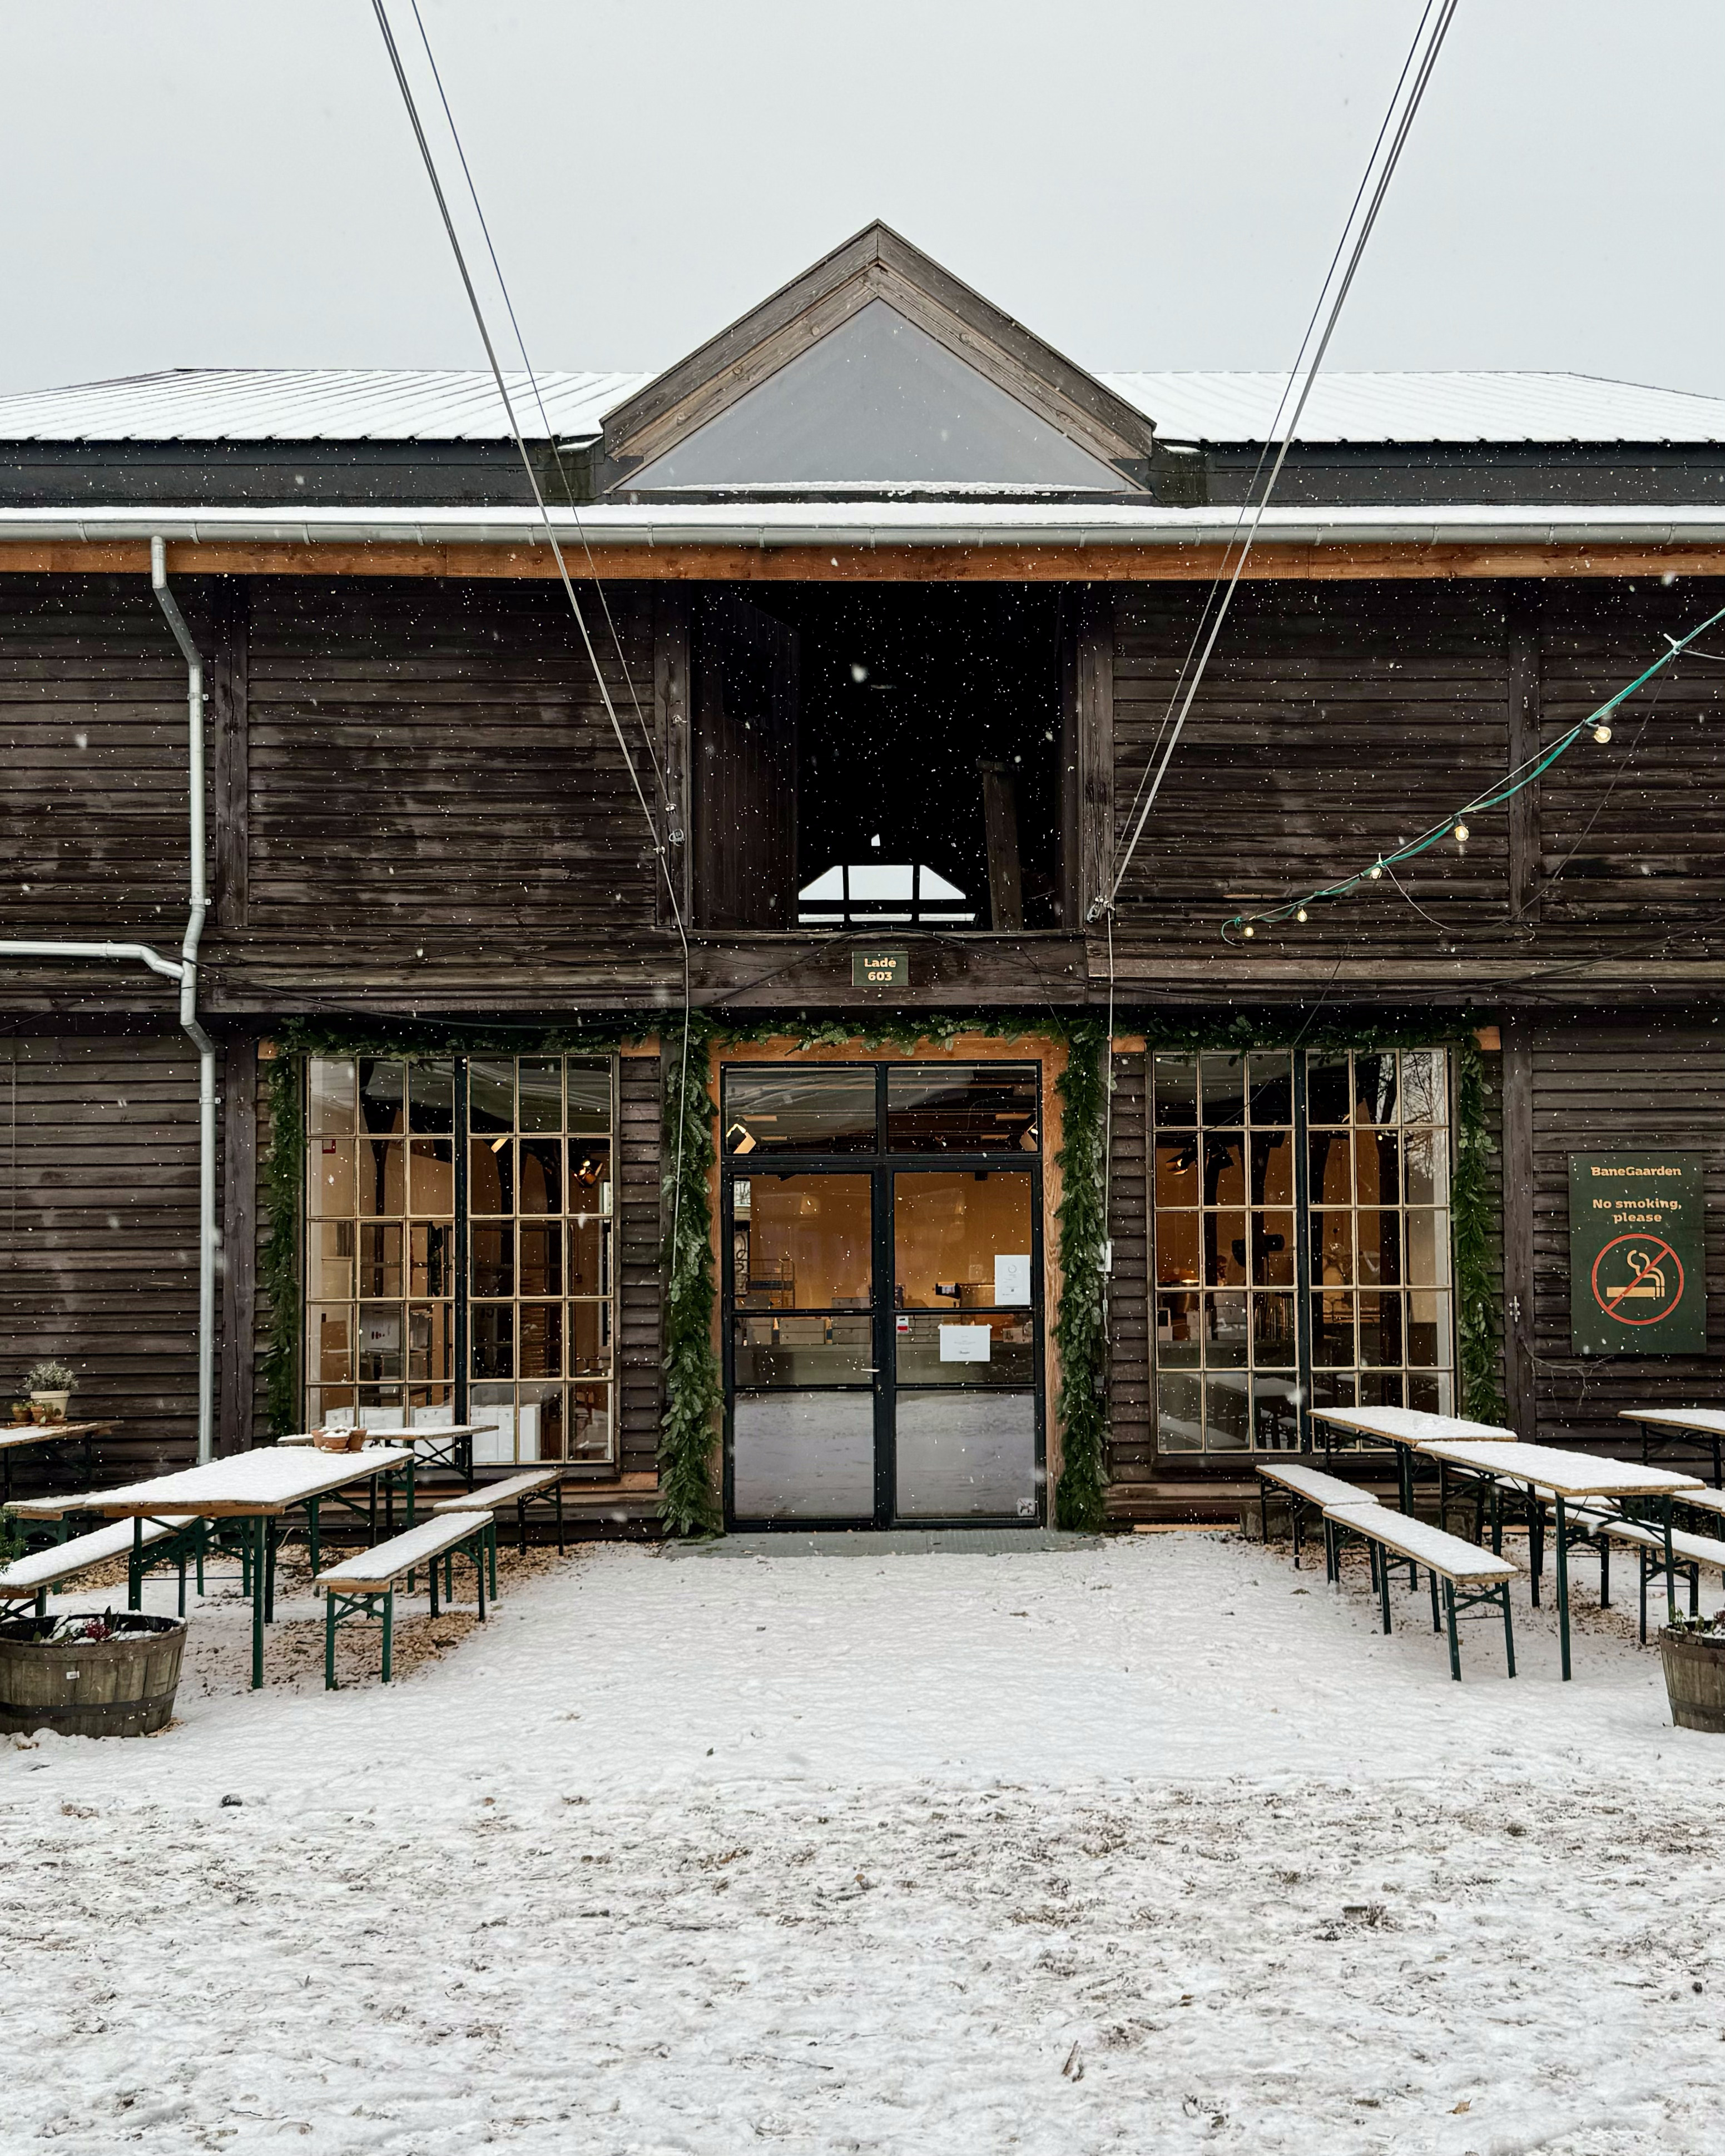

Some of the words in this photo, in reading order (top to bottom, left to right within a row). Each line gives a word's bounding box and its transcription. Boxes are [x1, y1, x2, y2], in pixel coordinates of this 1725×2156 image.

[864, 957, 896, 967] Lade
[868, 971, 893, 981] 603
[1591, 1166, 1682, 1176] BaneGaarden
[1593, 1199, 1612, 1209] No
[1615, 1198, 1682, 1210] smoking,
[1613, 1212, 1662, 1224] please
